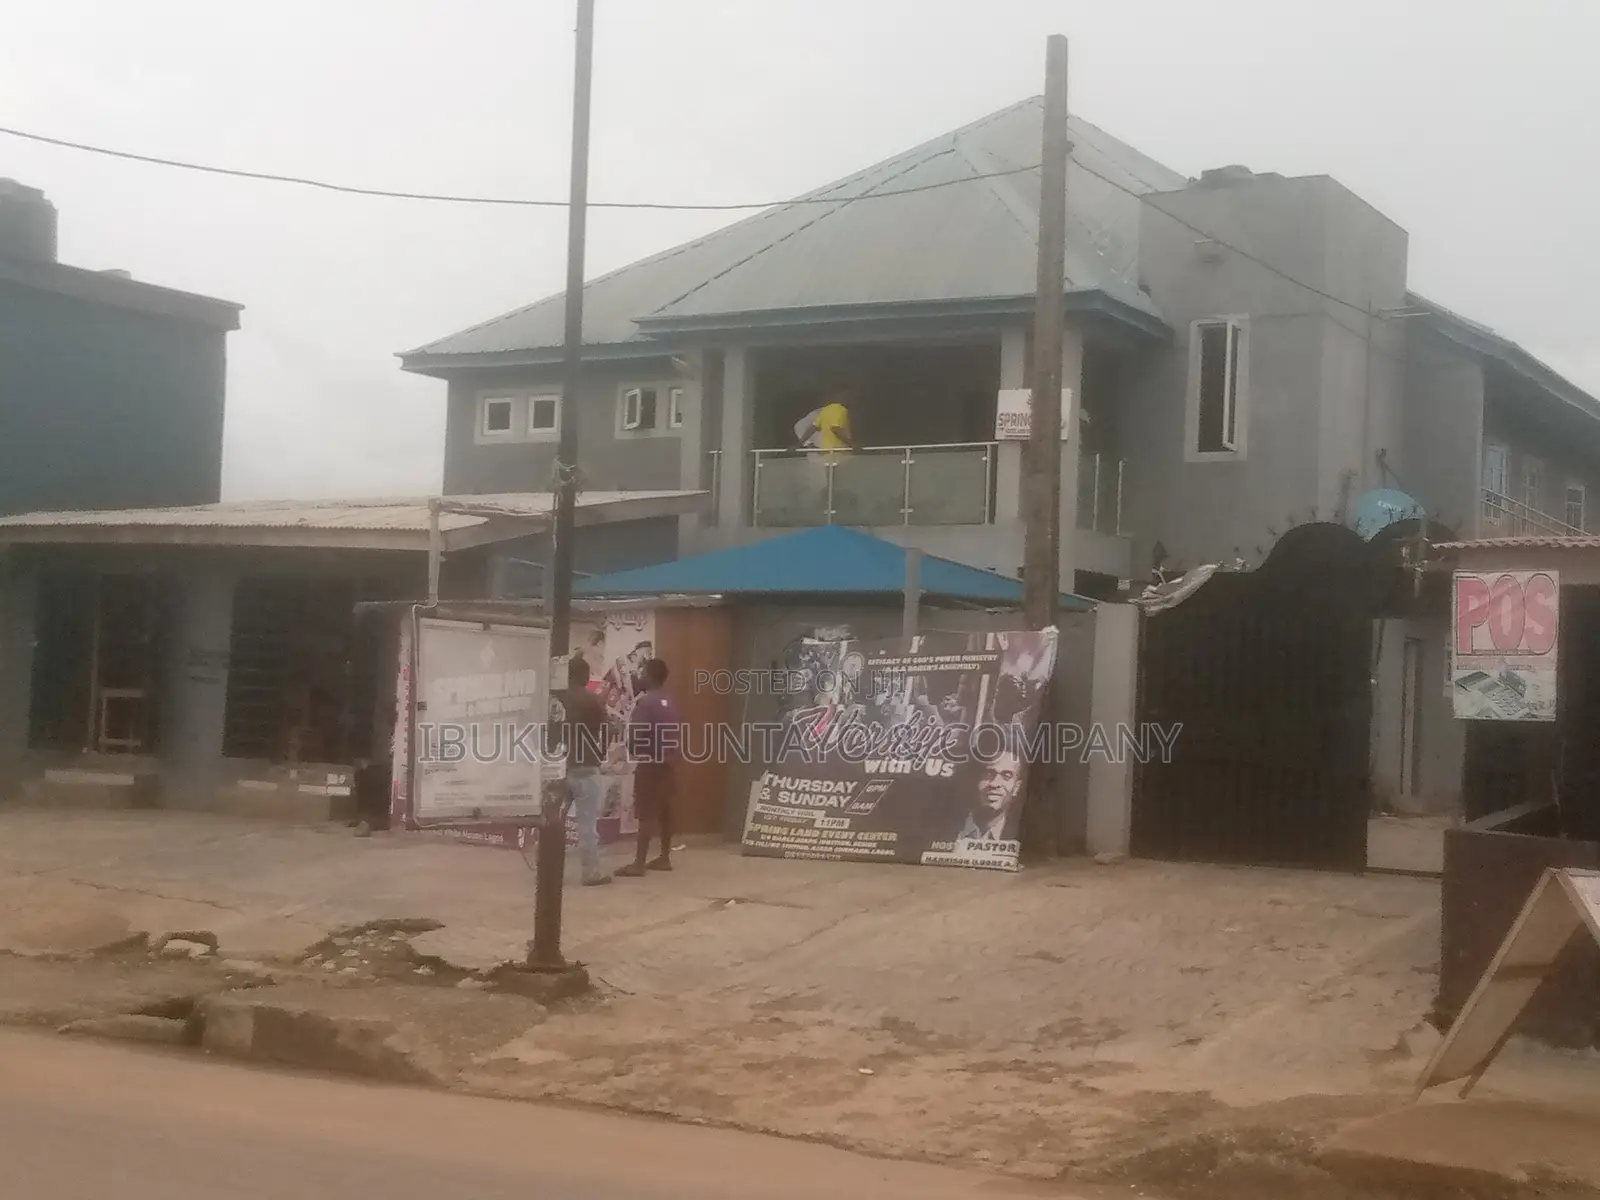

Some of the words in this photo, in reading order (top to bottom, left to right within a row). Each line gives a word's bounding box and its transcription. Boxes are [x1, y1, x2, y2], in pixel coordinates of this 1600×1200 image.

[1456, 573, 1557, 656] POS
[864, 756, 911, 774] with
[924, 757, 954, 777] Us
[763, 771, 858, 794] THURSDAY
[759, 786, 771, 801] &
[777, 790, 851, 808] SUNDAY
[749, 823, 789, 836] SPRING
[789, 827, 820, 838] LAND
[967, 842, 1017, 853] PASTOR
